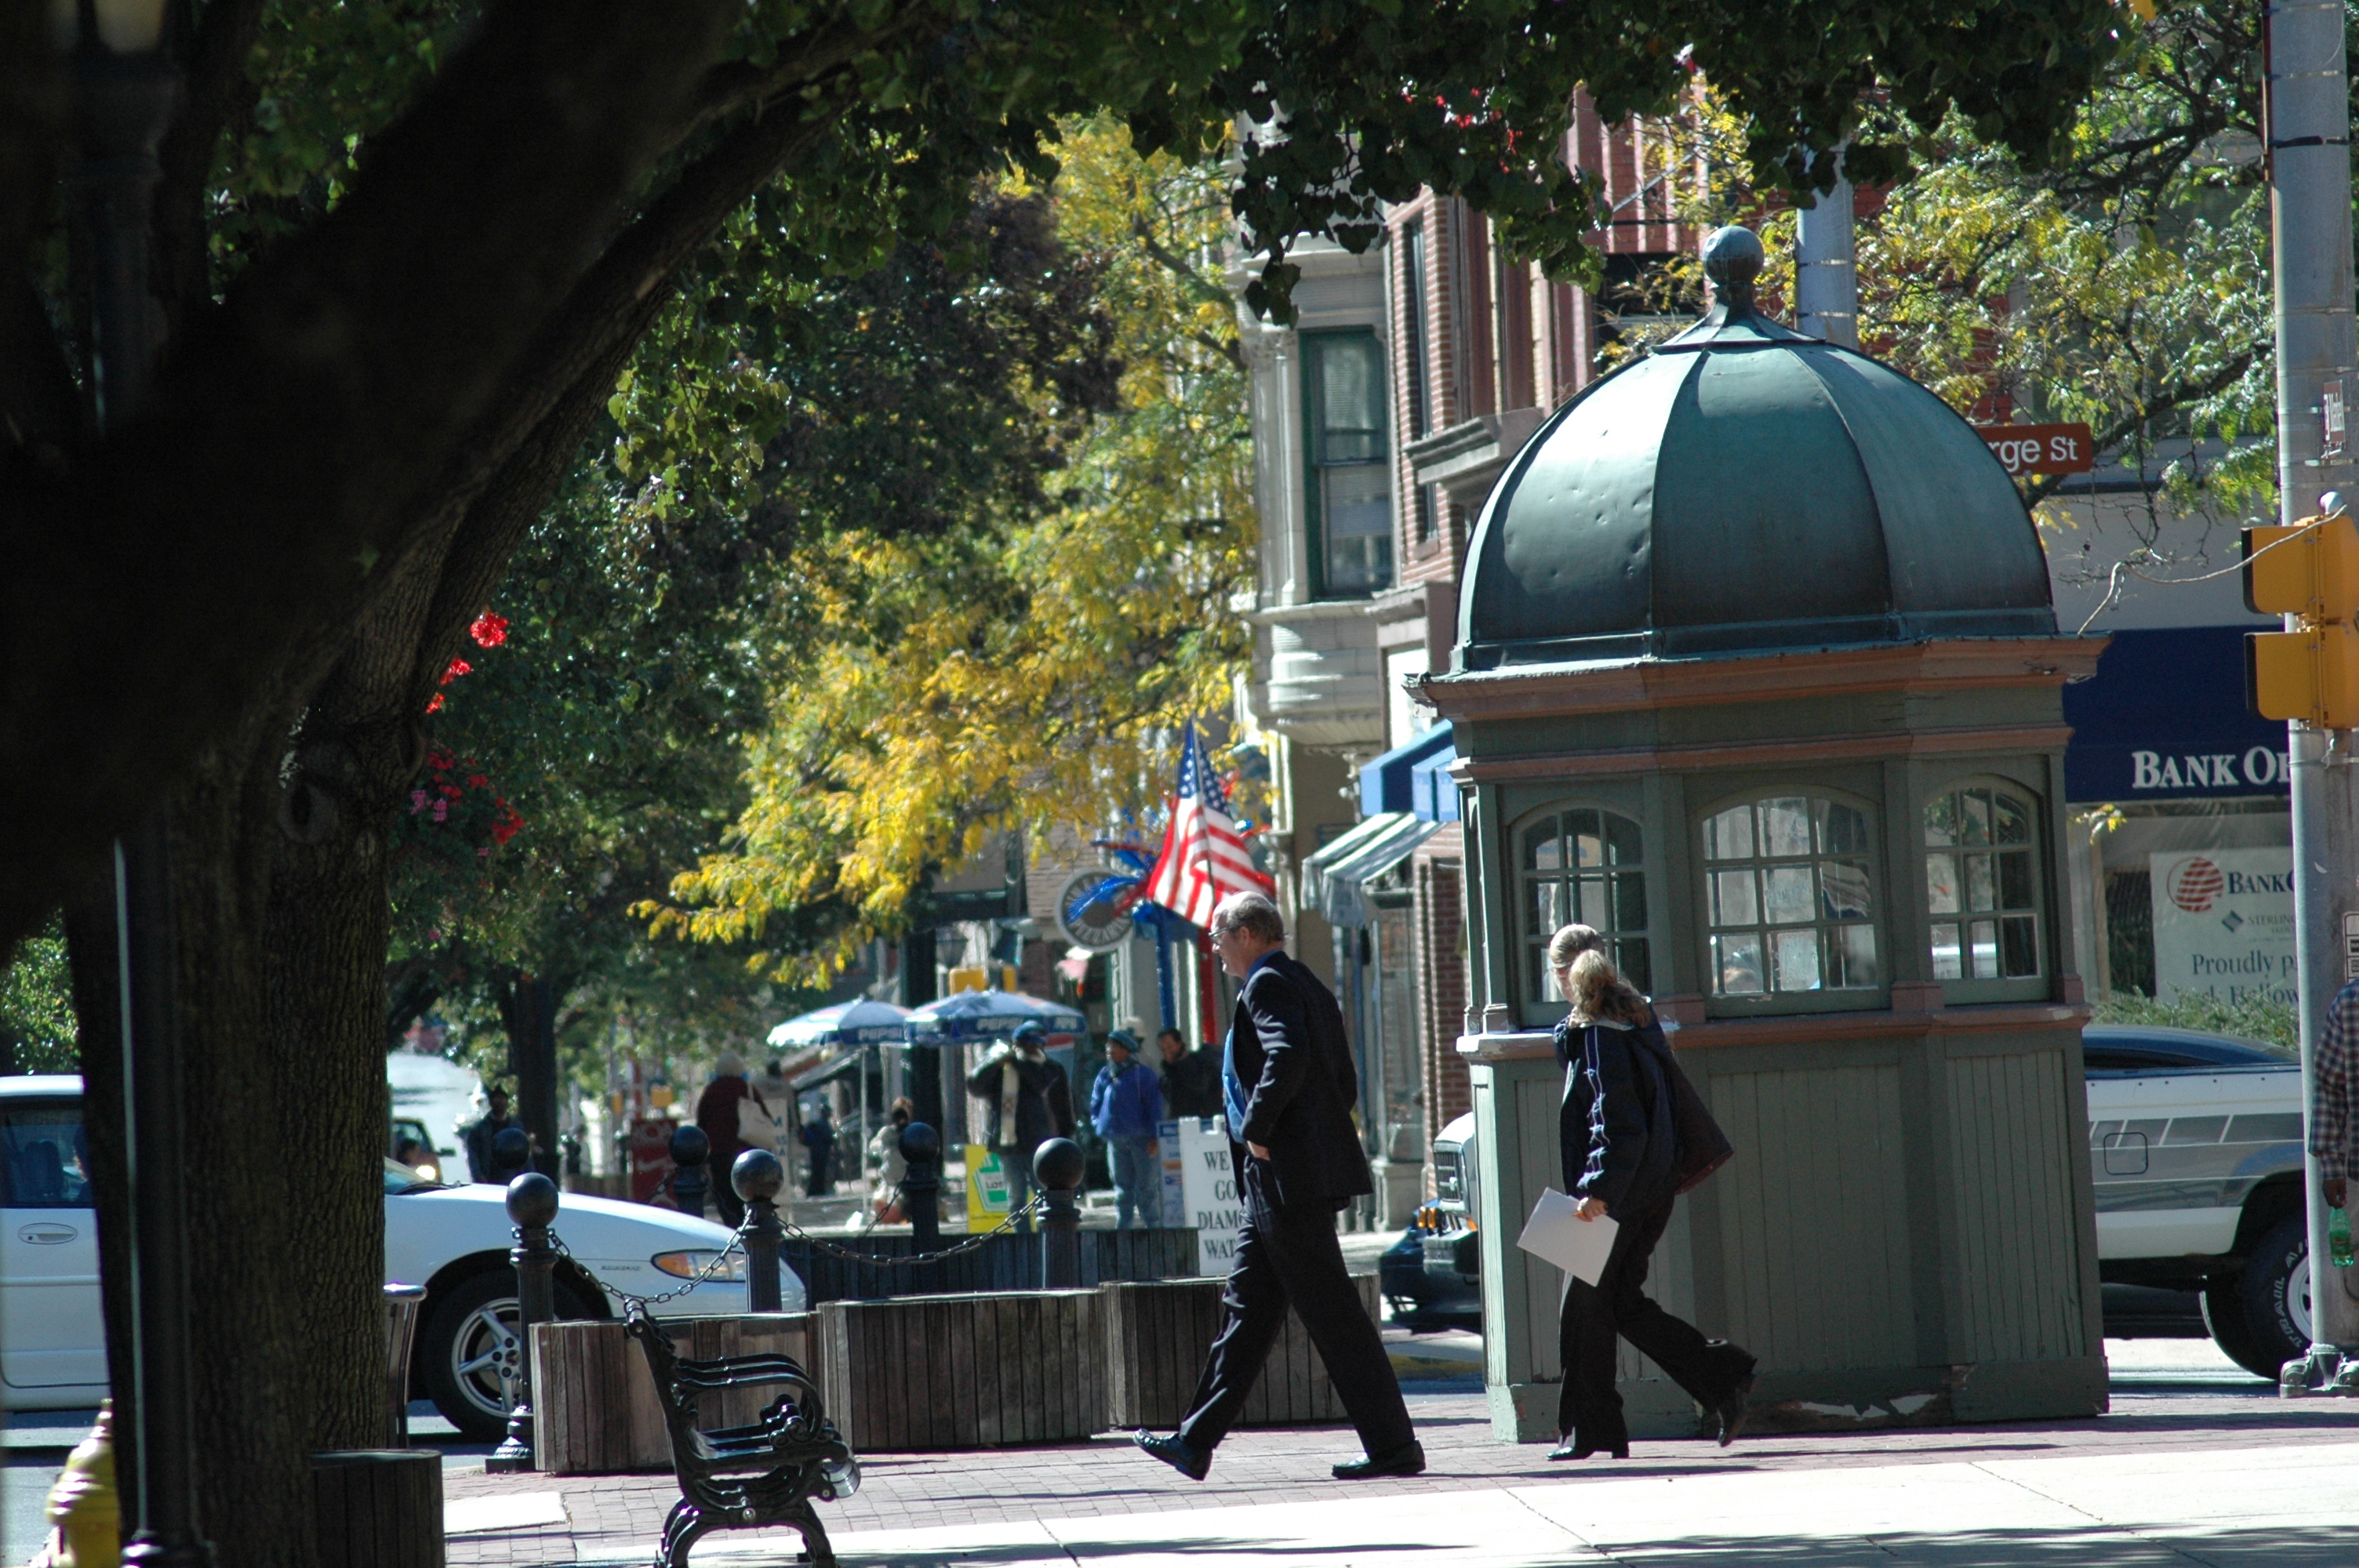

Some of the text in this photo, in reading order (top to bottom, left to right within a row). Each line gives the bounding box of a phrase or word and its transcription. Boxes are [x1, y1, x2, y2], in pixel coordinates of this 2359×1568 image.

[2050, 436, 2078, 461] St
[2132, 750, 2239, 789] BANK
[2192, 949, 2273, 979] Proudly
[1204, 1150, 1230, 1171] WE
